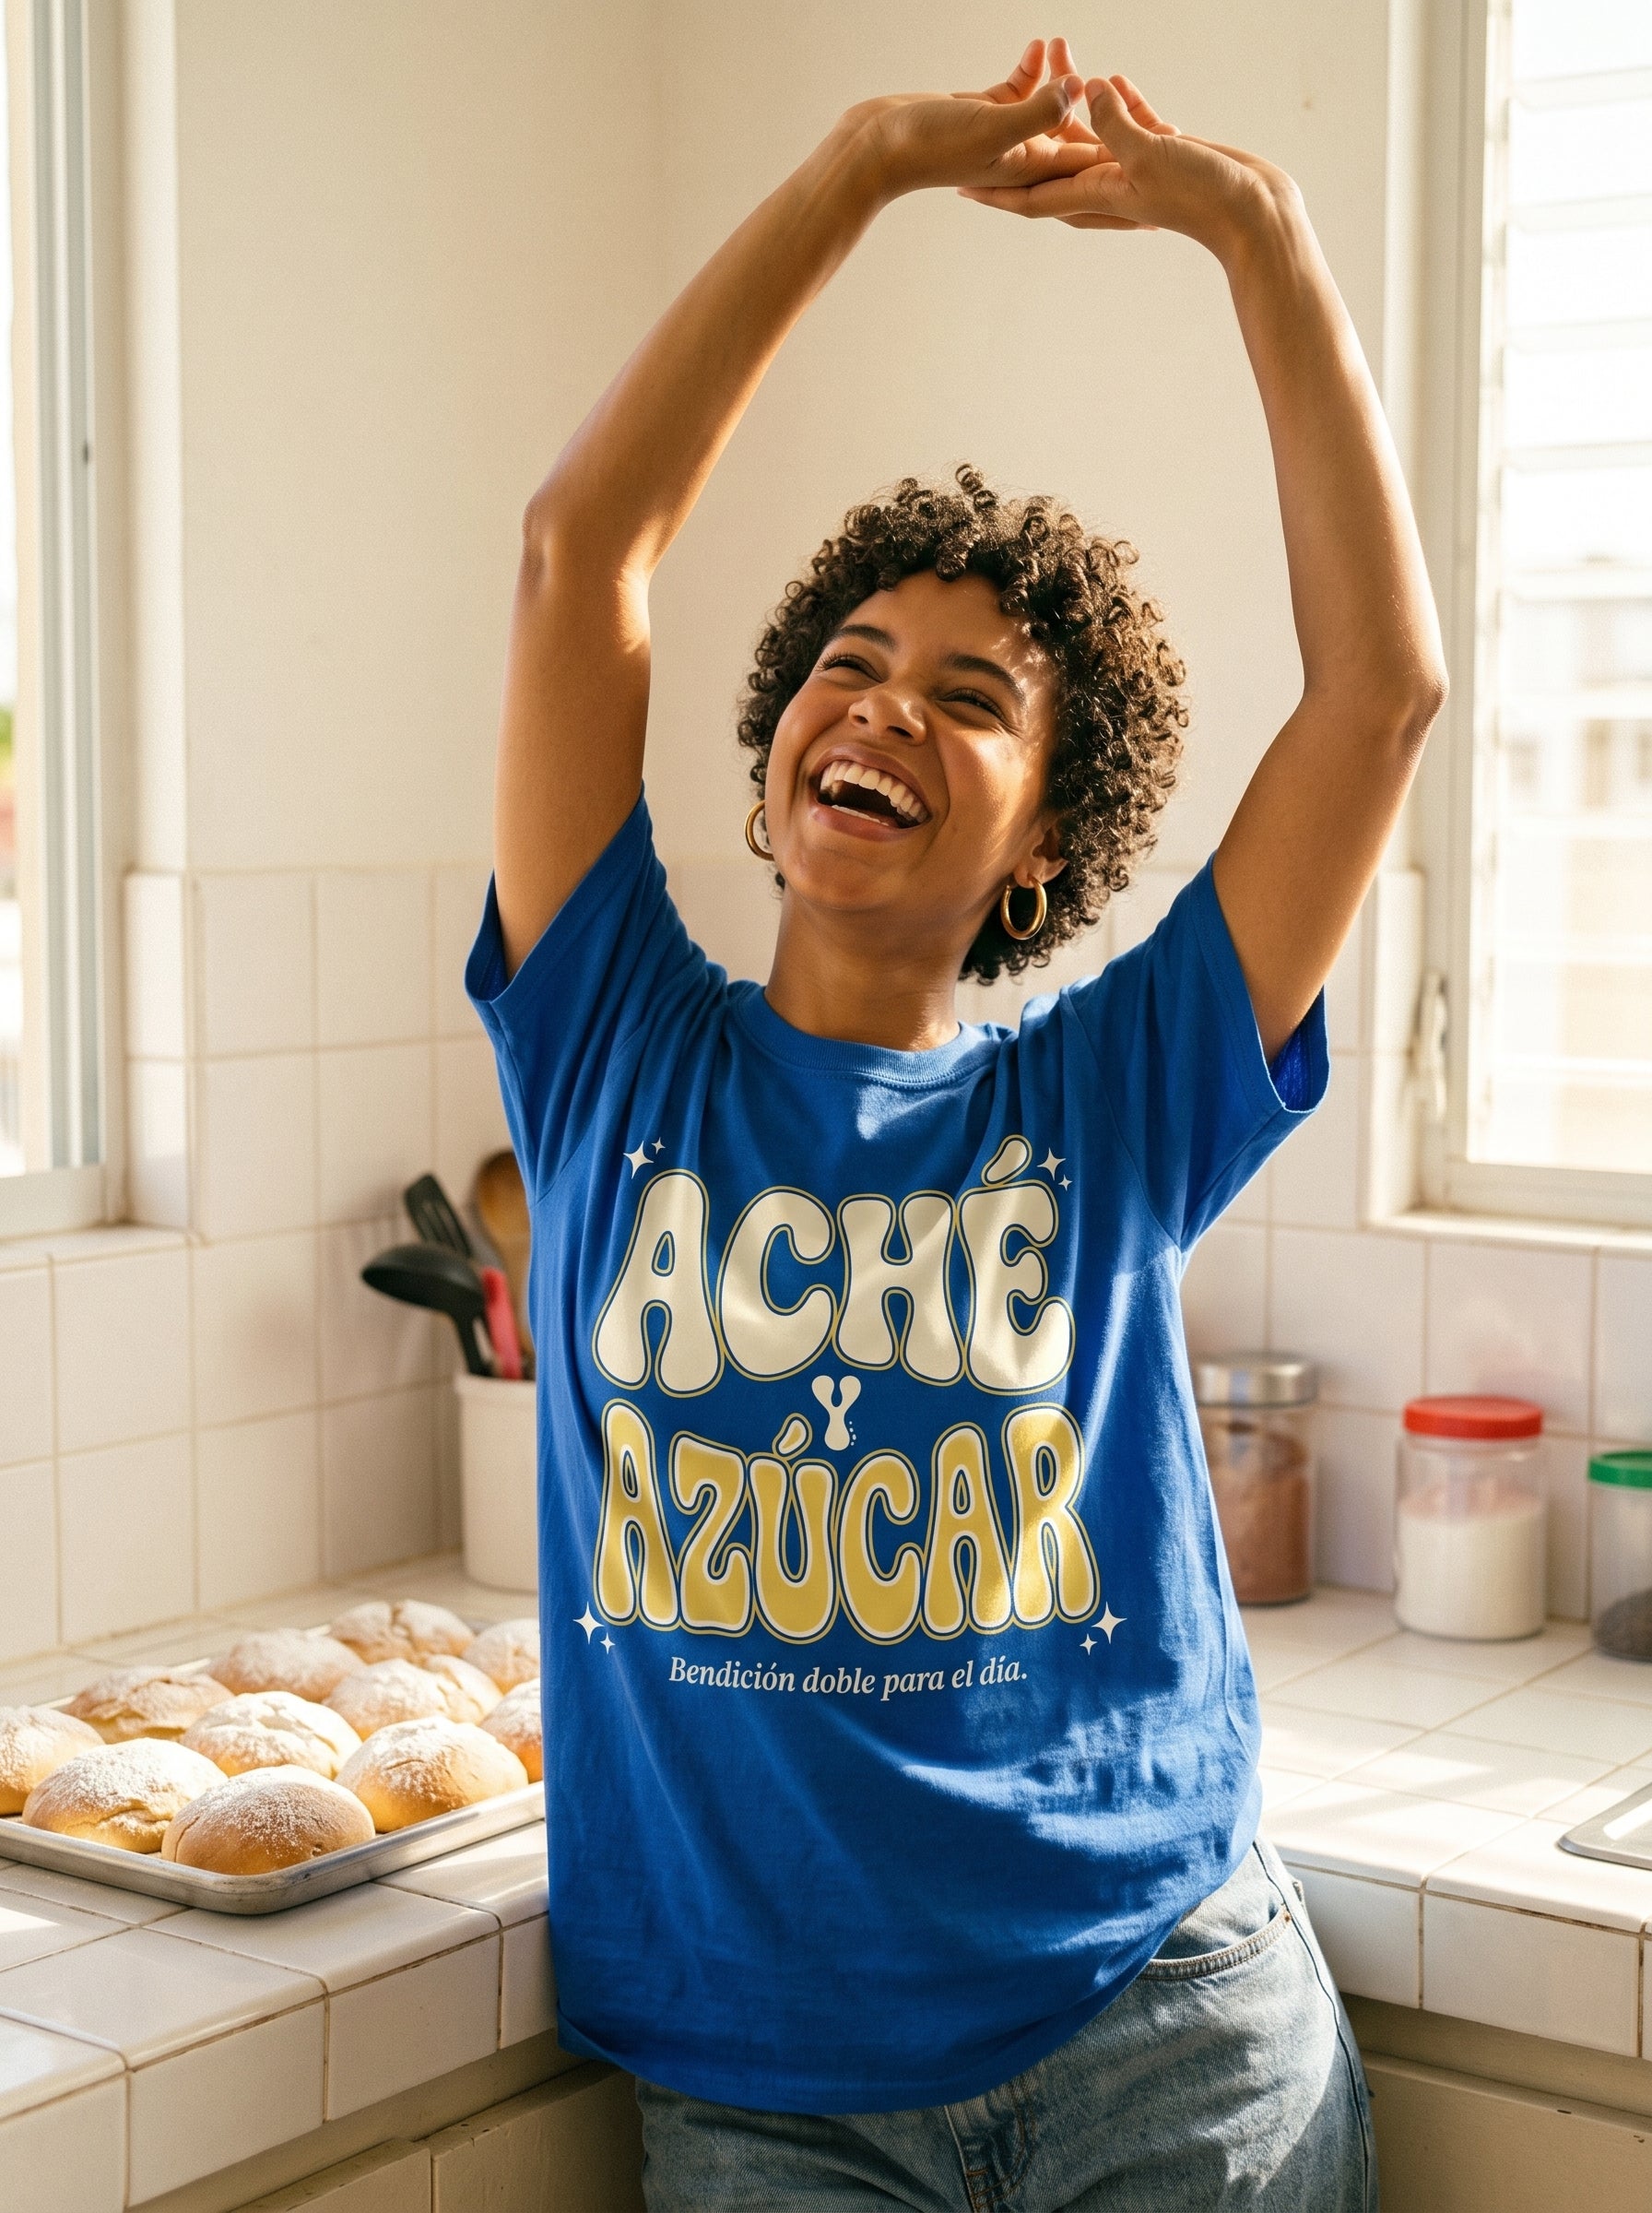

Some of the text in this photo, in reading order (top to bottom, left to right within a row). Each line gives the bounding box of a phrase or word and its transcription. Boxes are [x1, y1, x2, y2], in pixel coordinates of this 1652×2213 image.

[593, 1135, 1076, 1398] ACHÉ
[811, 1375, 861, 1450] Y
[595, 1399, 1101, 1645] AZÚCAR
[669, 1655, 1028, 1701] Bendición doble para el día.
